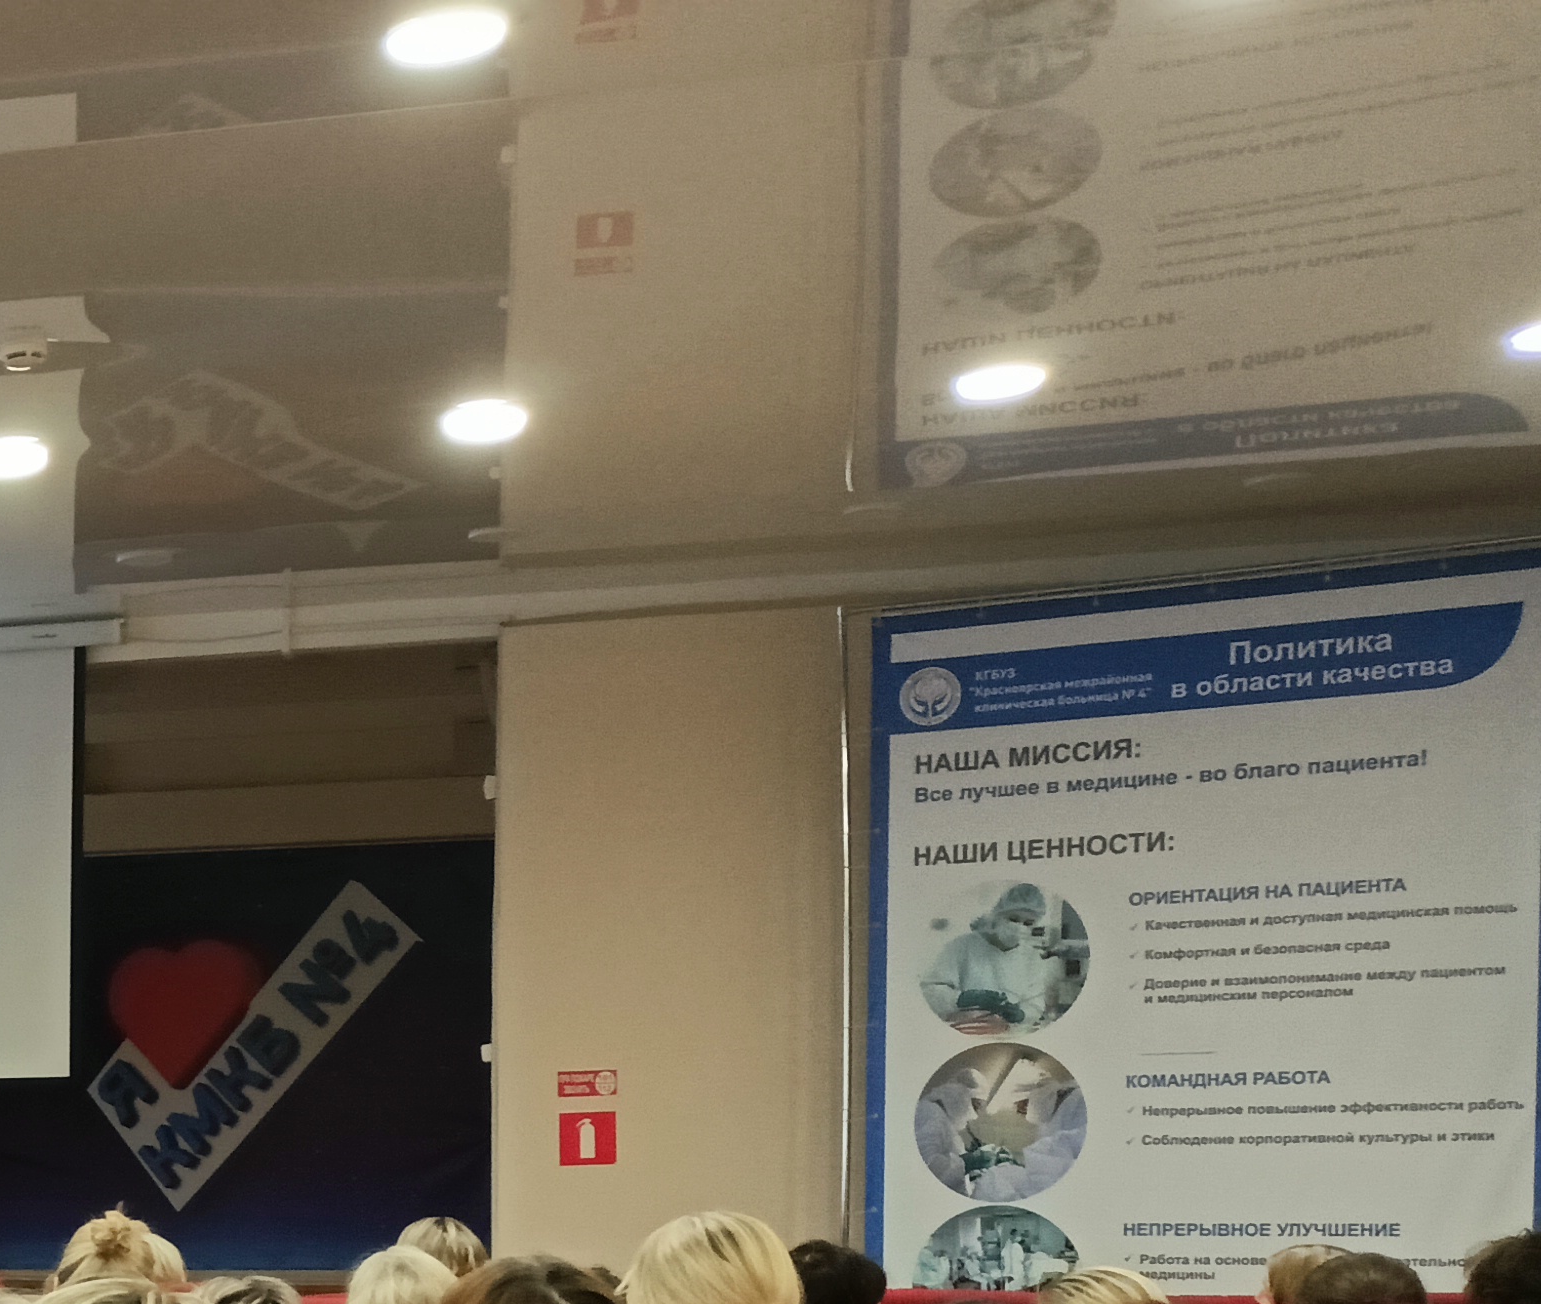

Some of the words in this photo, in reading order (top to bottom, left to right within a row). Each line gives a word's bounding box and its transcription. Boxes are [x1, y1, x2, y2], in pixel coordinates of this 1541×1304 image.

[1228, 632, 1393, 666] Политика
[975, 667, 1016, 681] КГБУЗ
[1171, 682, 1187, 699] в
[1196, 670, 1313, 698] области
[1322, 658, 1454, 685] качества
[915, 749, 1000, 774] НАША
[1008, 738, 1142, 768] МИССИЯ:
[915, 786, 953, 803] Все
[959, 781, 1040, 803] лучшее
[1046, 780, 1060, 793] в
[1067, 771, 1178, 792] медицине
[1199, 767, 1227, 783] во
[1234, 762, 1300, 780] благо
[1308, 749, 1428, 775] пациента!
[914, 841, 998, 867] НАШИ
[1007, 831, 1175, 864] ЦЕННОСТИ:
[1128, 884, 1260, 907] ОРИЕНТАЦИЯ
[1265, 883, 1293, 899] НА
[1298, 877, 1407, 898] ПАЦИЕНТА
[1145, 916, 1246, 931] Качественная
[1249, 916, 1259, 926] и
[1262, 911, 1343, 927] доступная
[1347, 906, 1450, 921] медицинская
[1454, 903, 1518, 917] помощь
[1145, 947, 1236, 961] Комфортная
[1240, 946, 1250, 956] и
[1254, 942, 1341, 955] безопасная
[1344, 939, 1390, 953] среда
[1143, 977, 1207, 991] Доверие
[1210, 977, 1220, 987] и
[1224, 971, 1362, 987] взаимопонимание
[1366, 969, 1416, 982] между
[1420, 966, 1506, 980] пациентом
[1145, 994, 1153, 1004] и
[1157, 991, 1257, 1005] медицинским
[1261, 987, 1354, 1002] персоналом
[1126, 1072, 1247, 1089] КОМАНДНАЯ
[1253, 1070, 1331, 1085] РАБОТА
[97, 1058, 159, 1129] Я
[1142, 1105, 1244, 1118] Непрерывное
[1248, 1103, 1336, 1116] повышение
[1340, 1101, 1464, 1115] эффективности
[1141, 1134, 1235, 1147] Соблюдение
[1239, 1131, 1354, 1146] корпоративной
[1359, 1131, 1433, 1145] культуры
[1437, 1132, 1447, 1142] и
[1451, 1131, 1495, 1142] этики
[1123, 1222, 1271, 1237] НЕПРЕРЫВНОЕ
[1277, 1222, 1401, 1237] УЛУЧШЕНИЕ
[1139, 1253, 1190, 1266] Работа
[1193, 1256, 1211, 1266] на
[1214, 1255, 1267, 1266] основе
